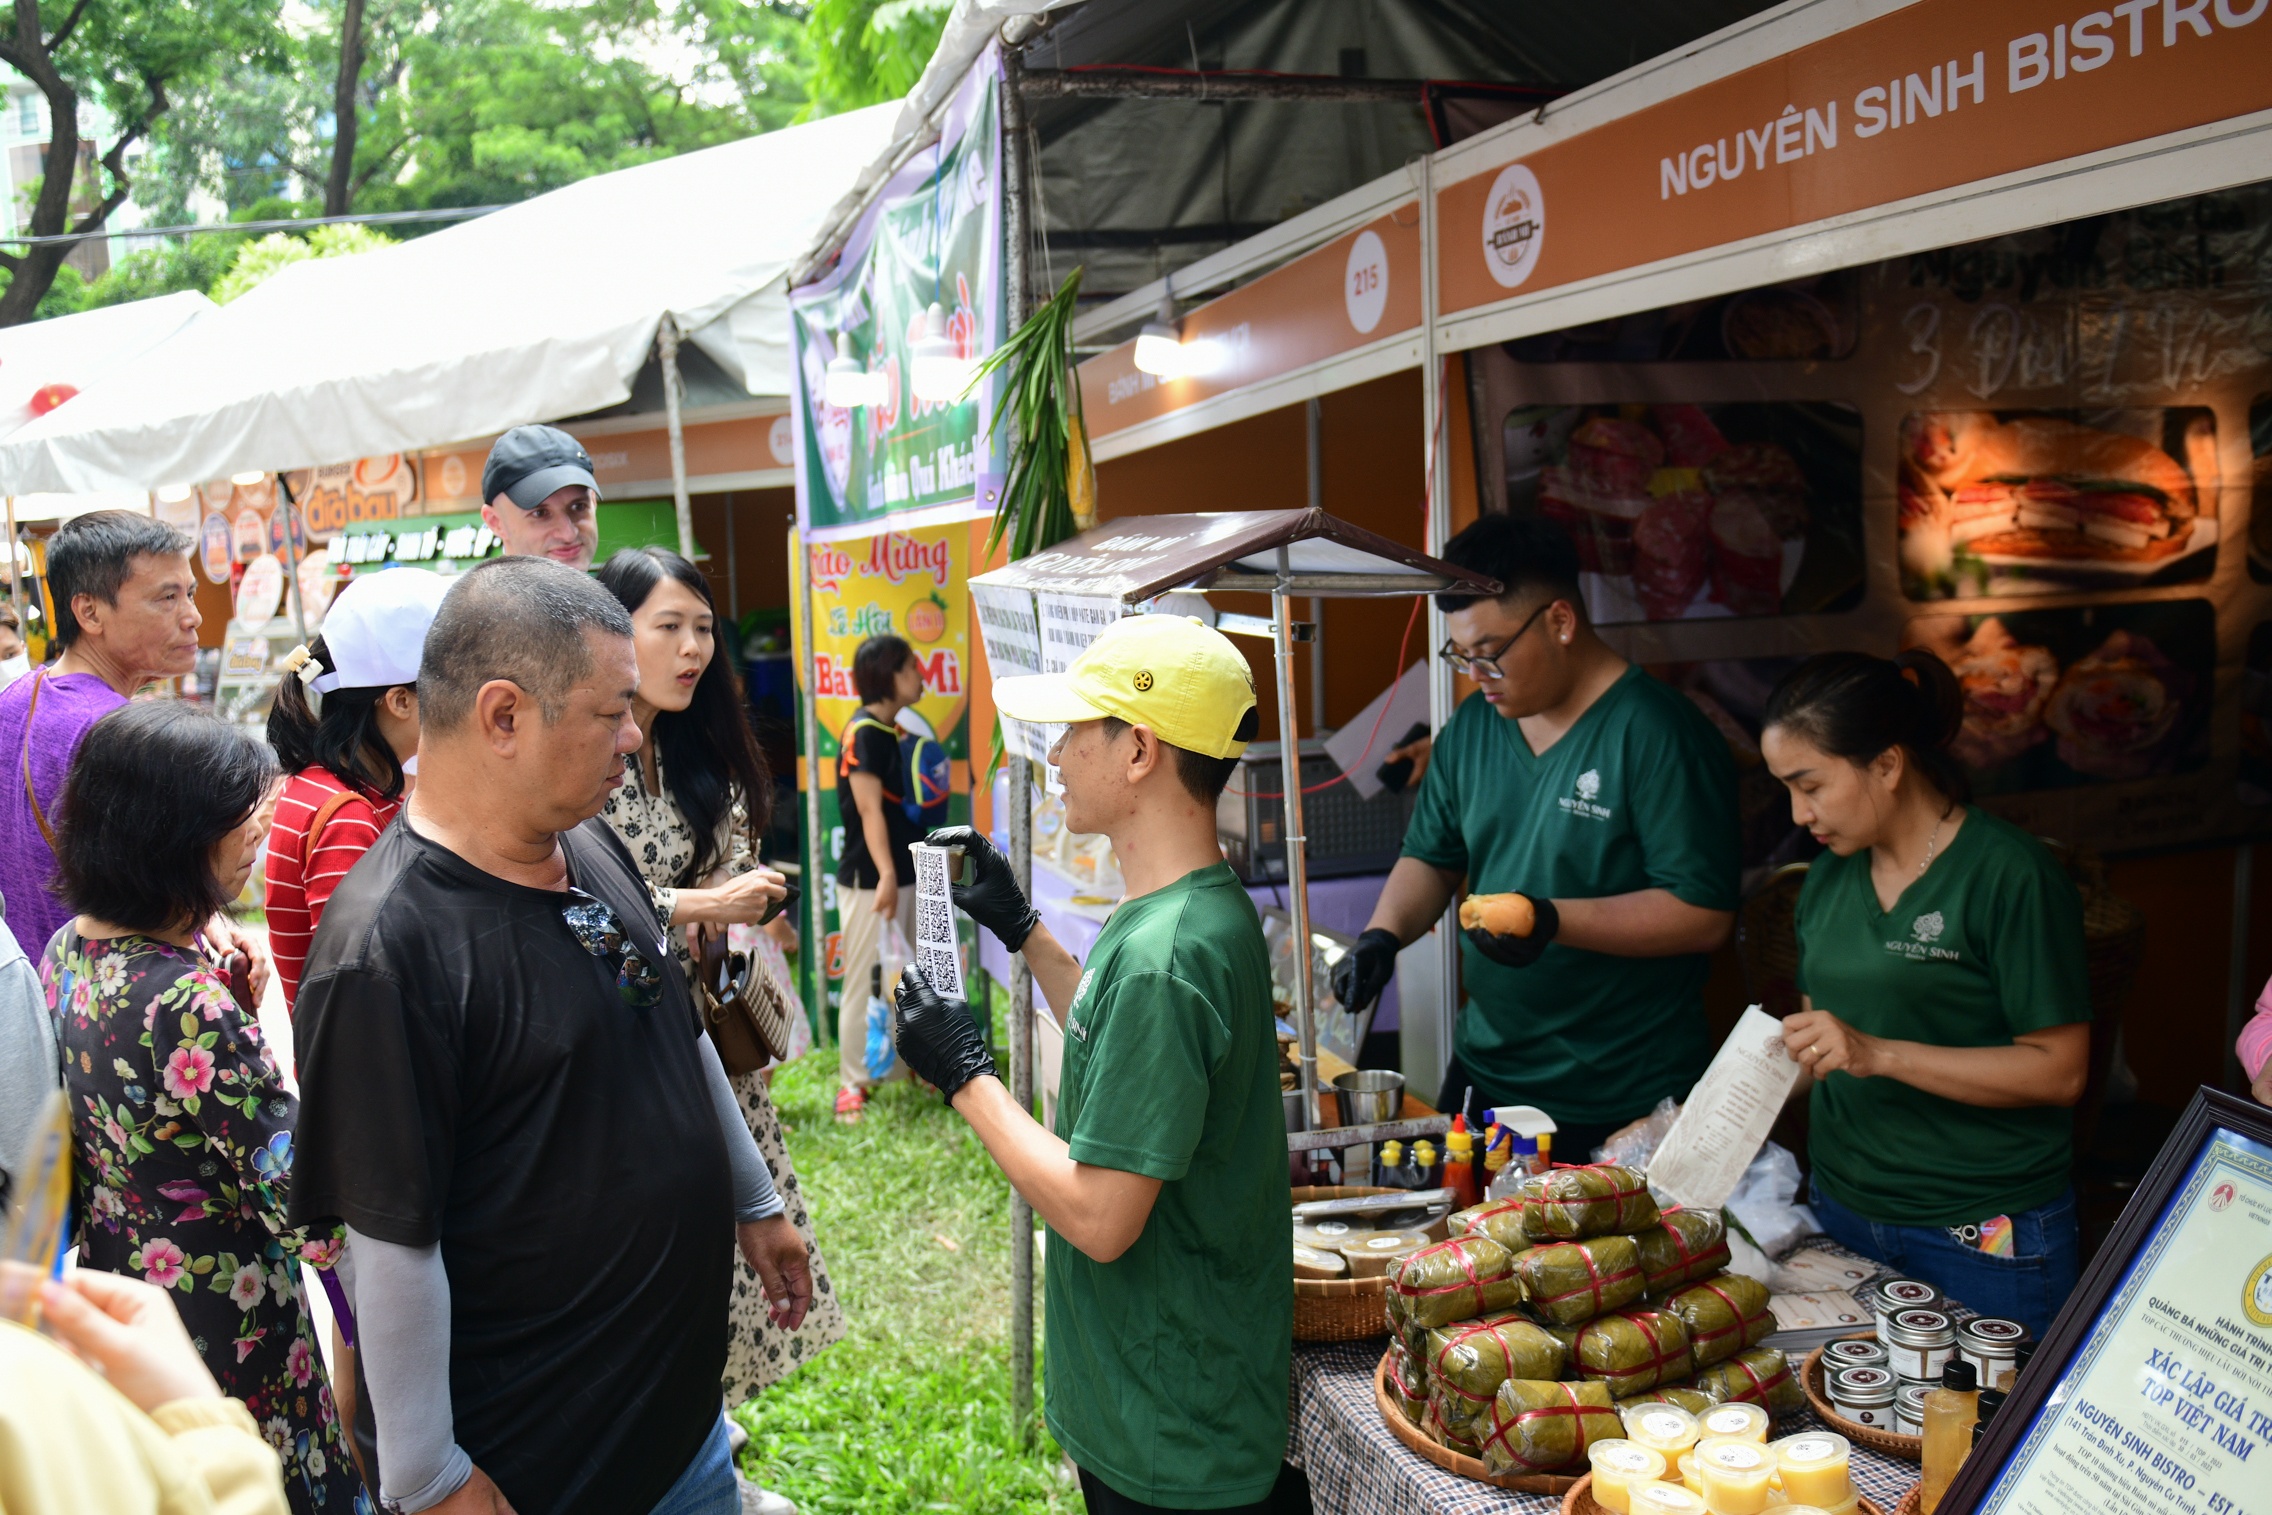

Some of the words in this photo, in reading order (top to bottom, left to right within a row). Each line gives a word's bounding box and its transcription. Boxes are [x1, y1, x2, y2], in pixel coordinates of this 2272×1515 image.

[1660, 101, 1837, 200] NGUYÊN
[1854, 65, 1984, 138] SINH
[2008, 0, 2270, 94] BISTRO
[1353, 264, 1379, 296] 215
[1896, 301, 1941, 395] 3
[859, 532, 950, 585] Mừng
[1019, 552, 1116, 575] NGUYÊN
[1091, 533, 1160, 551] BÁNH
[914, 650, 961, 694] Mì
[1884, 940, 1928, 955] NGUYÊN
[1929, 946, 1960, 960] SINH
[2141, 1313, 2156, 1325] TOP
[2148, 1296, 2181, 1320] QUẢNG
[2180, 1315, 2197, 1329] BÁ
[2195, 1322, 2230, 1349] NHỮNG
[2229, 1343, 2249, 1360] GIÁ
[2248, 1353, 2266, 1372] TRỊ
[2215, 1316, 2245, 1339] HÀNH
[2144, 1347, 2183, 1380] XÁC
[2178, 1368, 2216, 1400] LẬP
[2213, 1390, 2249, 1424] GIÁ
[2141, 1376, 2175, 1407] TOP
[2174, 1397, 2215, 1434] VIỆT
[2210, 1422, 2256, 1463] NAM
[2064, 1415, 2082, 1432] (141
[2126, 1460, 2135, 1473] P.
[2075, 1398, 2124, 1440] NGUYÊN
[2120, 1431, 2154, 1462] SINH
[2151, 1452, 2196, 1491] BISTRO
[2195, 1447, 2207, 1457] TOP
[2210, 1457, 2223, 1469] 2023
[2200, 1460, 2213, 1472] 2023
[2077, 1445, 2093, 1460] TOP
[2131, 1485, 2148, 1503] Bánh
[2090, 1472, 2101, 1482] 50
[2121, 1495, 2132, 1508] Sài
